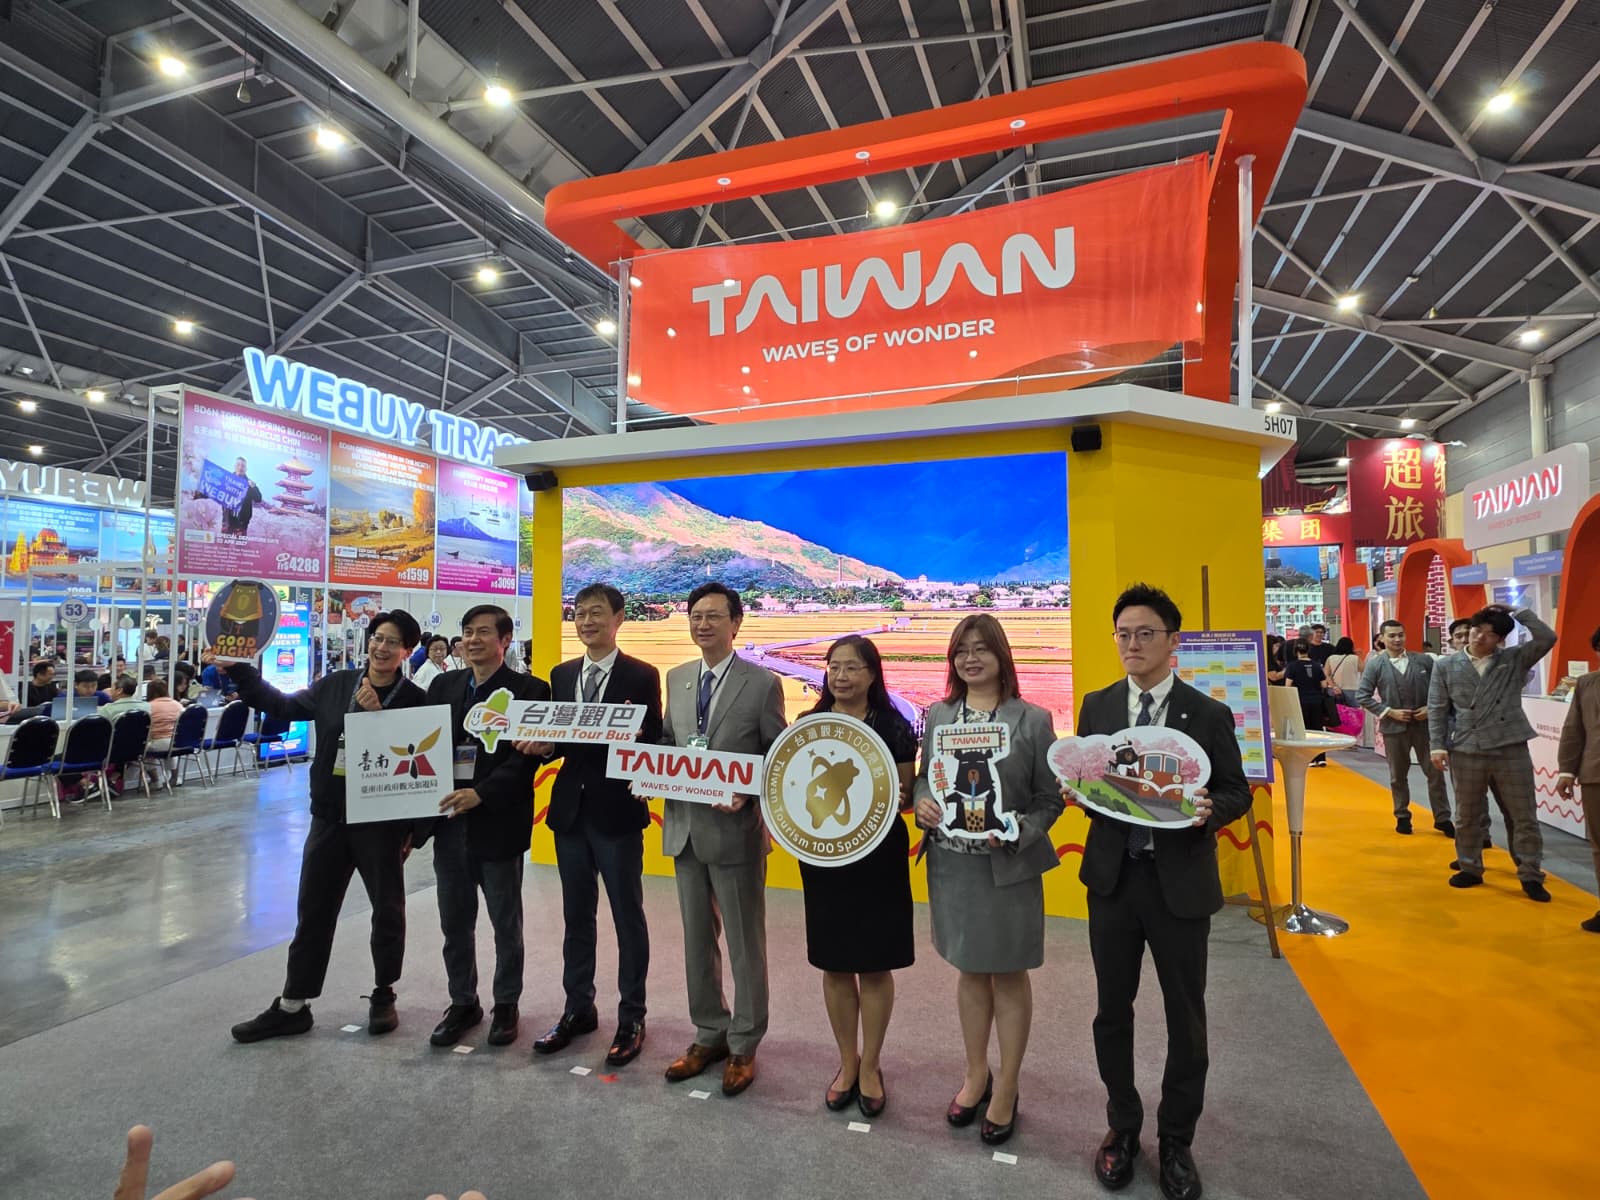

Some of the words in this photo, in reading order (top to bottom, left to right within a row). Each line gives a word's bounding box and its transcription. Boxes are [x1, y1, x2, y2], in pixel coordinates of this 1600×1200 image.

[692, 226, 1075, 336] TAIWAN
[762, 339, 839, 363] WAVES
[845, 333, 877, 352] OF
[883, 318, 996, 347] WONDER
[193, 403, 220, 417] 8D6N
[286, 427, 322, 443] BLOSSOM
[1264, 415, 1293, 436] 5H07
[281, 436, 301, 448] CHIN
[1472, 464, 1562, 520] TAIWAN
[1263, 518, 1321, 542] 集团
[289, 556, 320, 573] 4288
[406, 567, 430, 581] 1599
[65, 603, 83, 617] 53
[188, 612, 200, 622] 34
[216, 634, 257, 646] GOOD
[211, 645, 258, 658] NIGHT
[519, 703, 637, 728] 台灣觀巴
[516, 726, 567, 739] Taiwan
[571, 728, 604, 740] Tour
[605, 730, 632, 741] Bus
[951, 736, 991, 746] TAIWAN
[361, 771, 388, 779] TAINAN
[616, 749, 753, 786] TAIWAN
[640, 781, 670, 791] WAVES
[684, 786, 725, 798] WONDER
[770, 759, 786, 804] Taiwan
[774, 807, 809, 849] Tourism
[837, 801, 886, 853] Spotlights
[812, 841, 834, 854] 100
